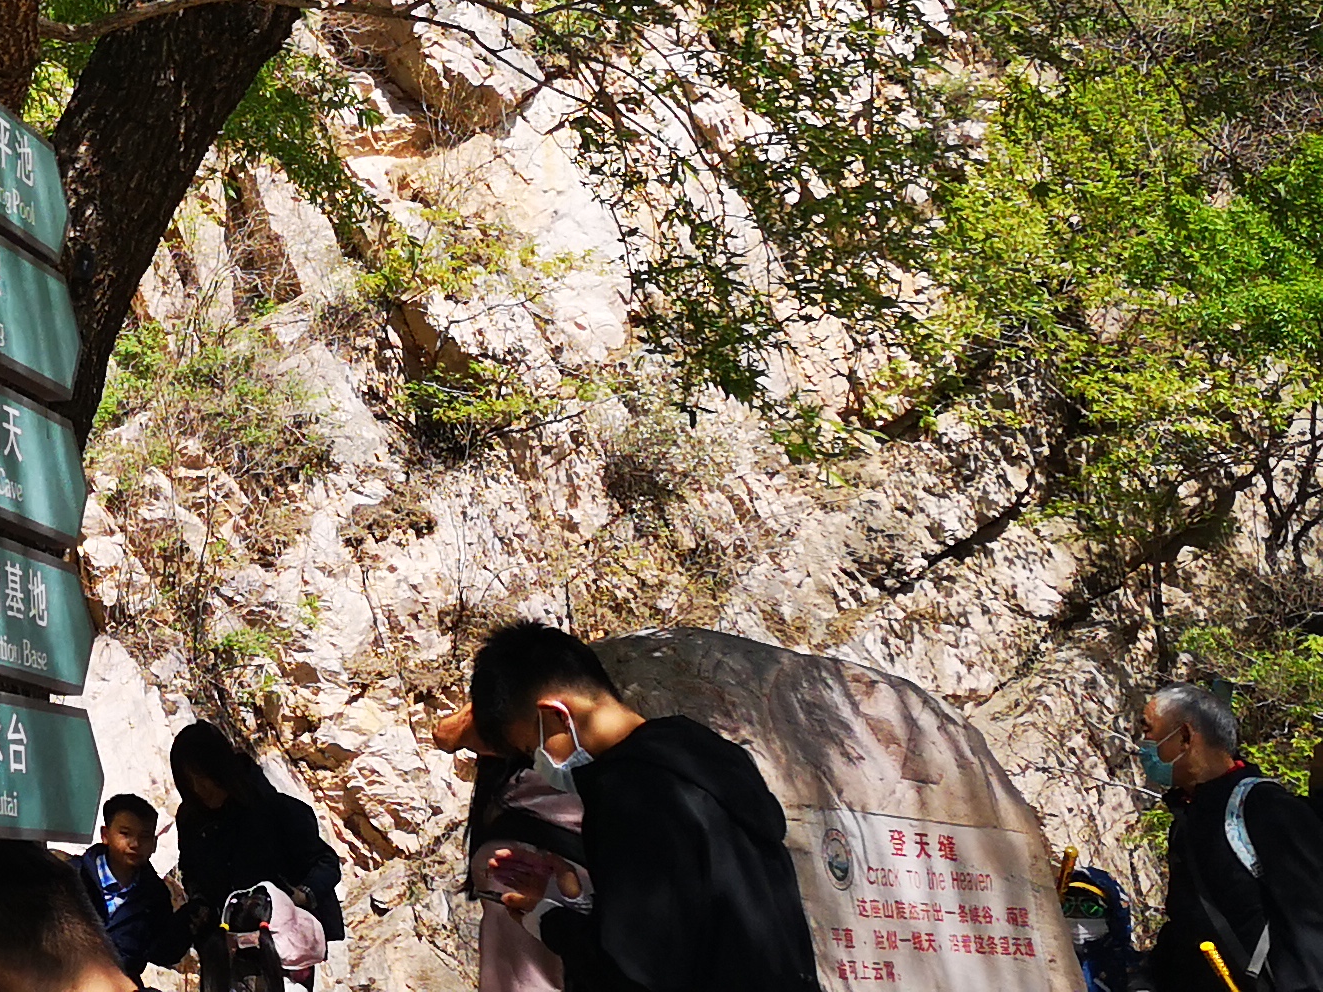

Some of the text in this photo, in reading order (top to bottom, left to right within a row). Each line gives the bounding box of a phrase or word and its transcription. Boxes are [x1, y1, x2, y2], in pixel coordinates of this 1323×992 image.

[23, 639, 47, 670] Base
[889, 829, 958, 862] 登天缝
[867, 865, 901, 888] Crack
[927, 866, 945, 891] the
[951, 869, 993, 893] Heaven
